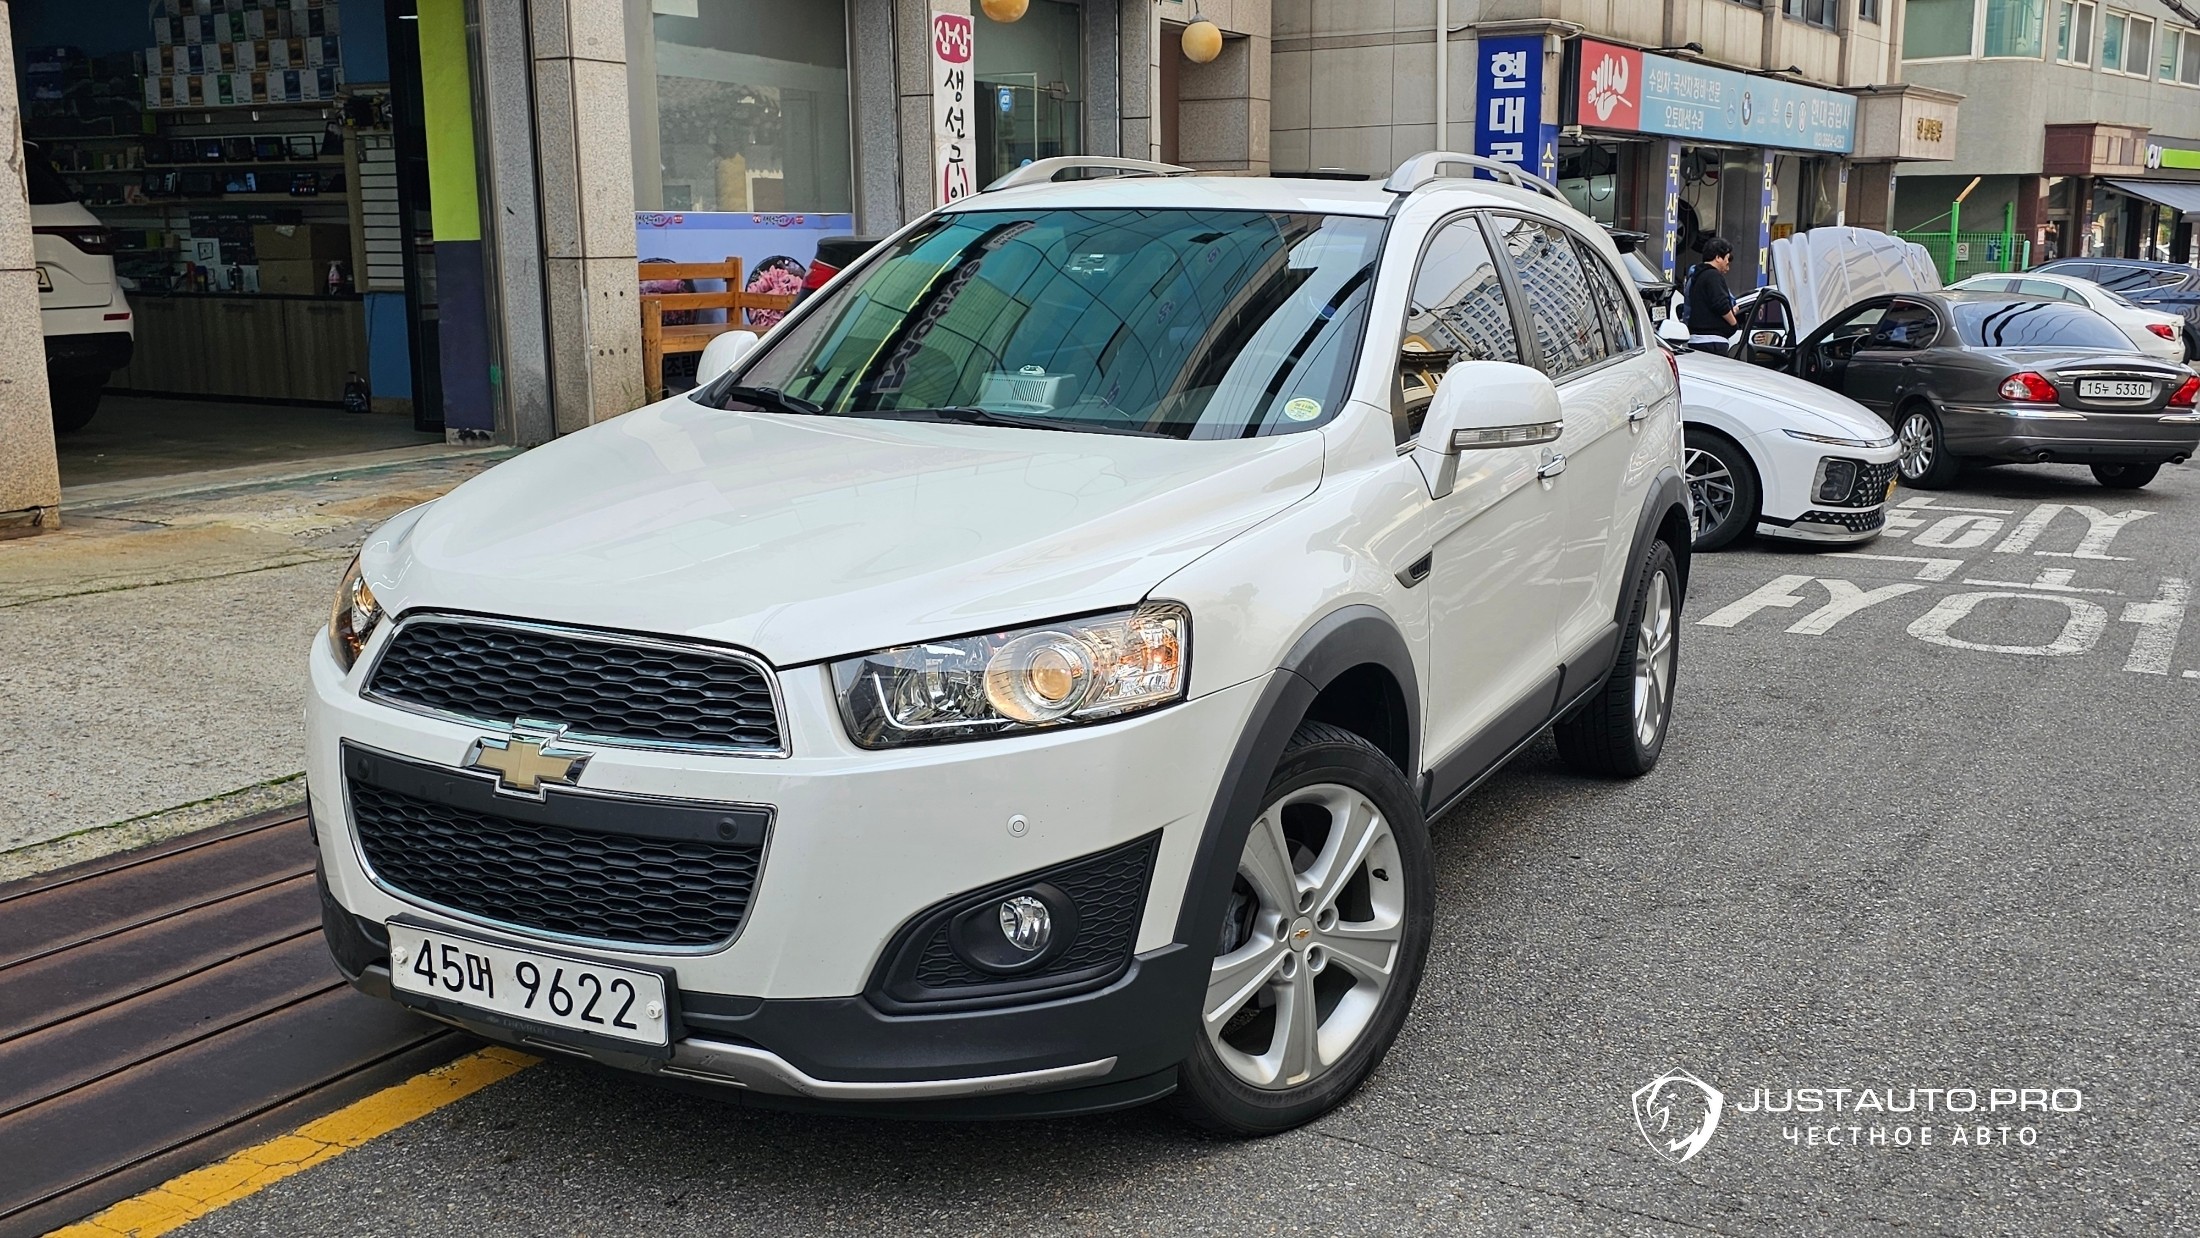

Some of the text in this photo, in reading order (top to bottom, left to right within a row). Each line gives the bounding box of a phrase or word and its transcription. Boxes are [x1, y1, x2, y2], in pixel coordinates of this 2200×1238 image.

[935, 20, 972, 57] 상상
[1811, 98, 1850, 129] 현대공업사
[2087, 382, 2110, 395] 15누
[2115, 383, 2145, 396] 5330
[414, 938, 638, 1030] 45머 9622
